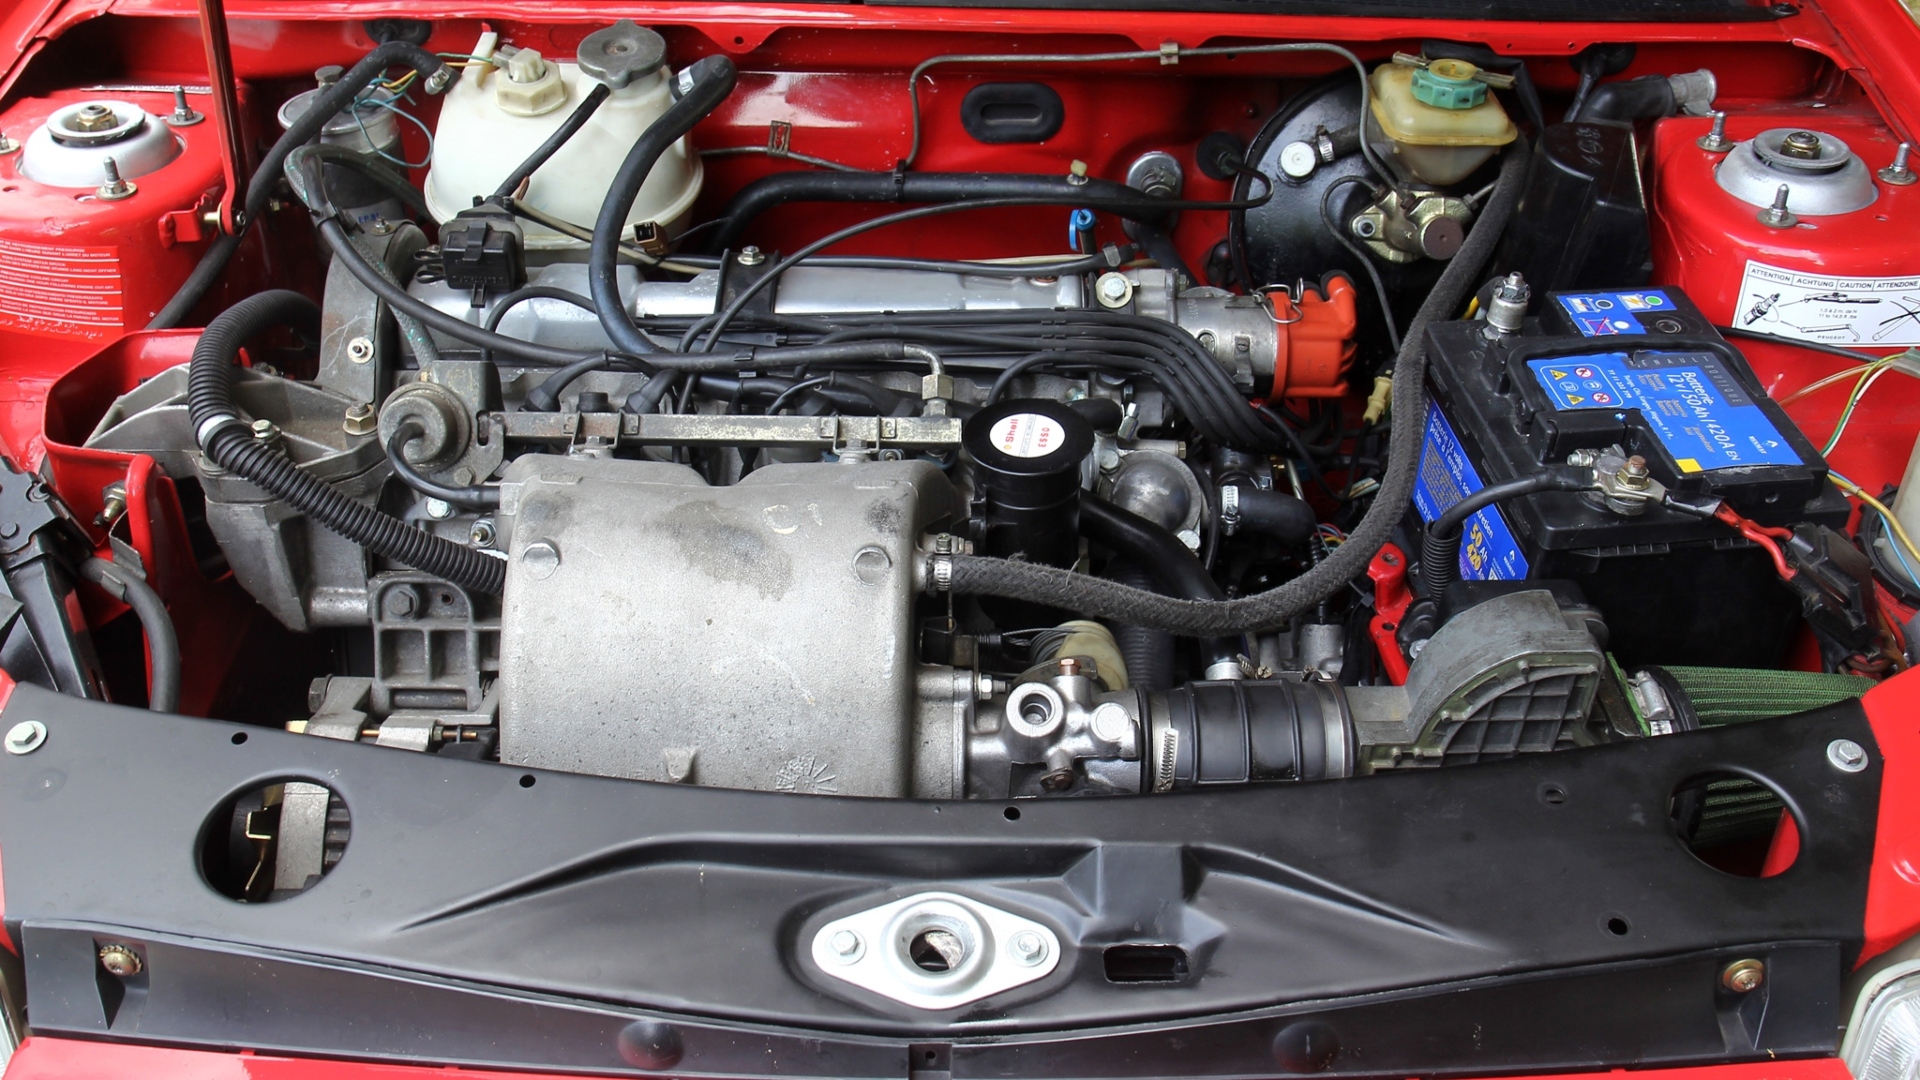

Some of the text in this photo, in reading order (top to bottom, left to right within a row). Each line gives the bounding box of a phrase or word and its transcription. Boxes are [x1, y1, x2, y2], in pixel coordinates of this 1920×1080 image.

[1751, 268, 1790, 282] ATTENTION
[1797, 278, 1834, 287] ACHTUNG
[1877, 280, 1918, 288] ATTENZIONE
[1681, 372, 1714, 405] Batterie
[1705, 365, 1742, 402] BOUTIQUE
[1005, 419, 1018, 443] Shell
[1038, 427, 1050, 448] ESSO
[1726, 450, 1741, 461] EN
[1470, 523, 1483, 547] 50
[1480, 547, 1488, 563] Ah
[1467, 543, 1481, 571] 420
